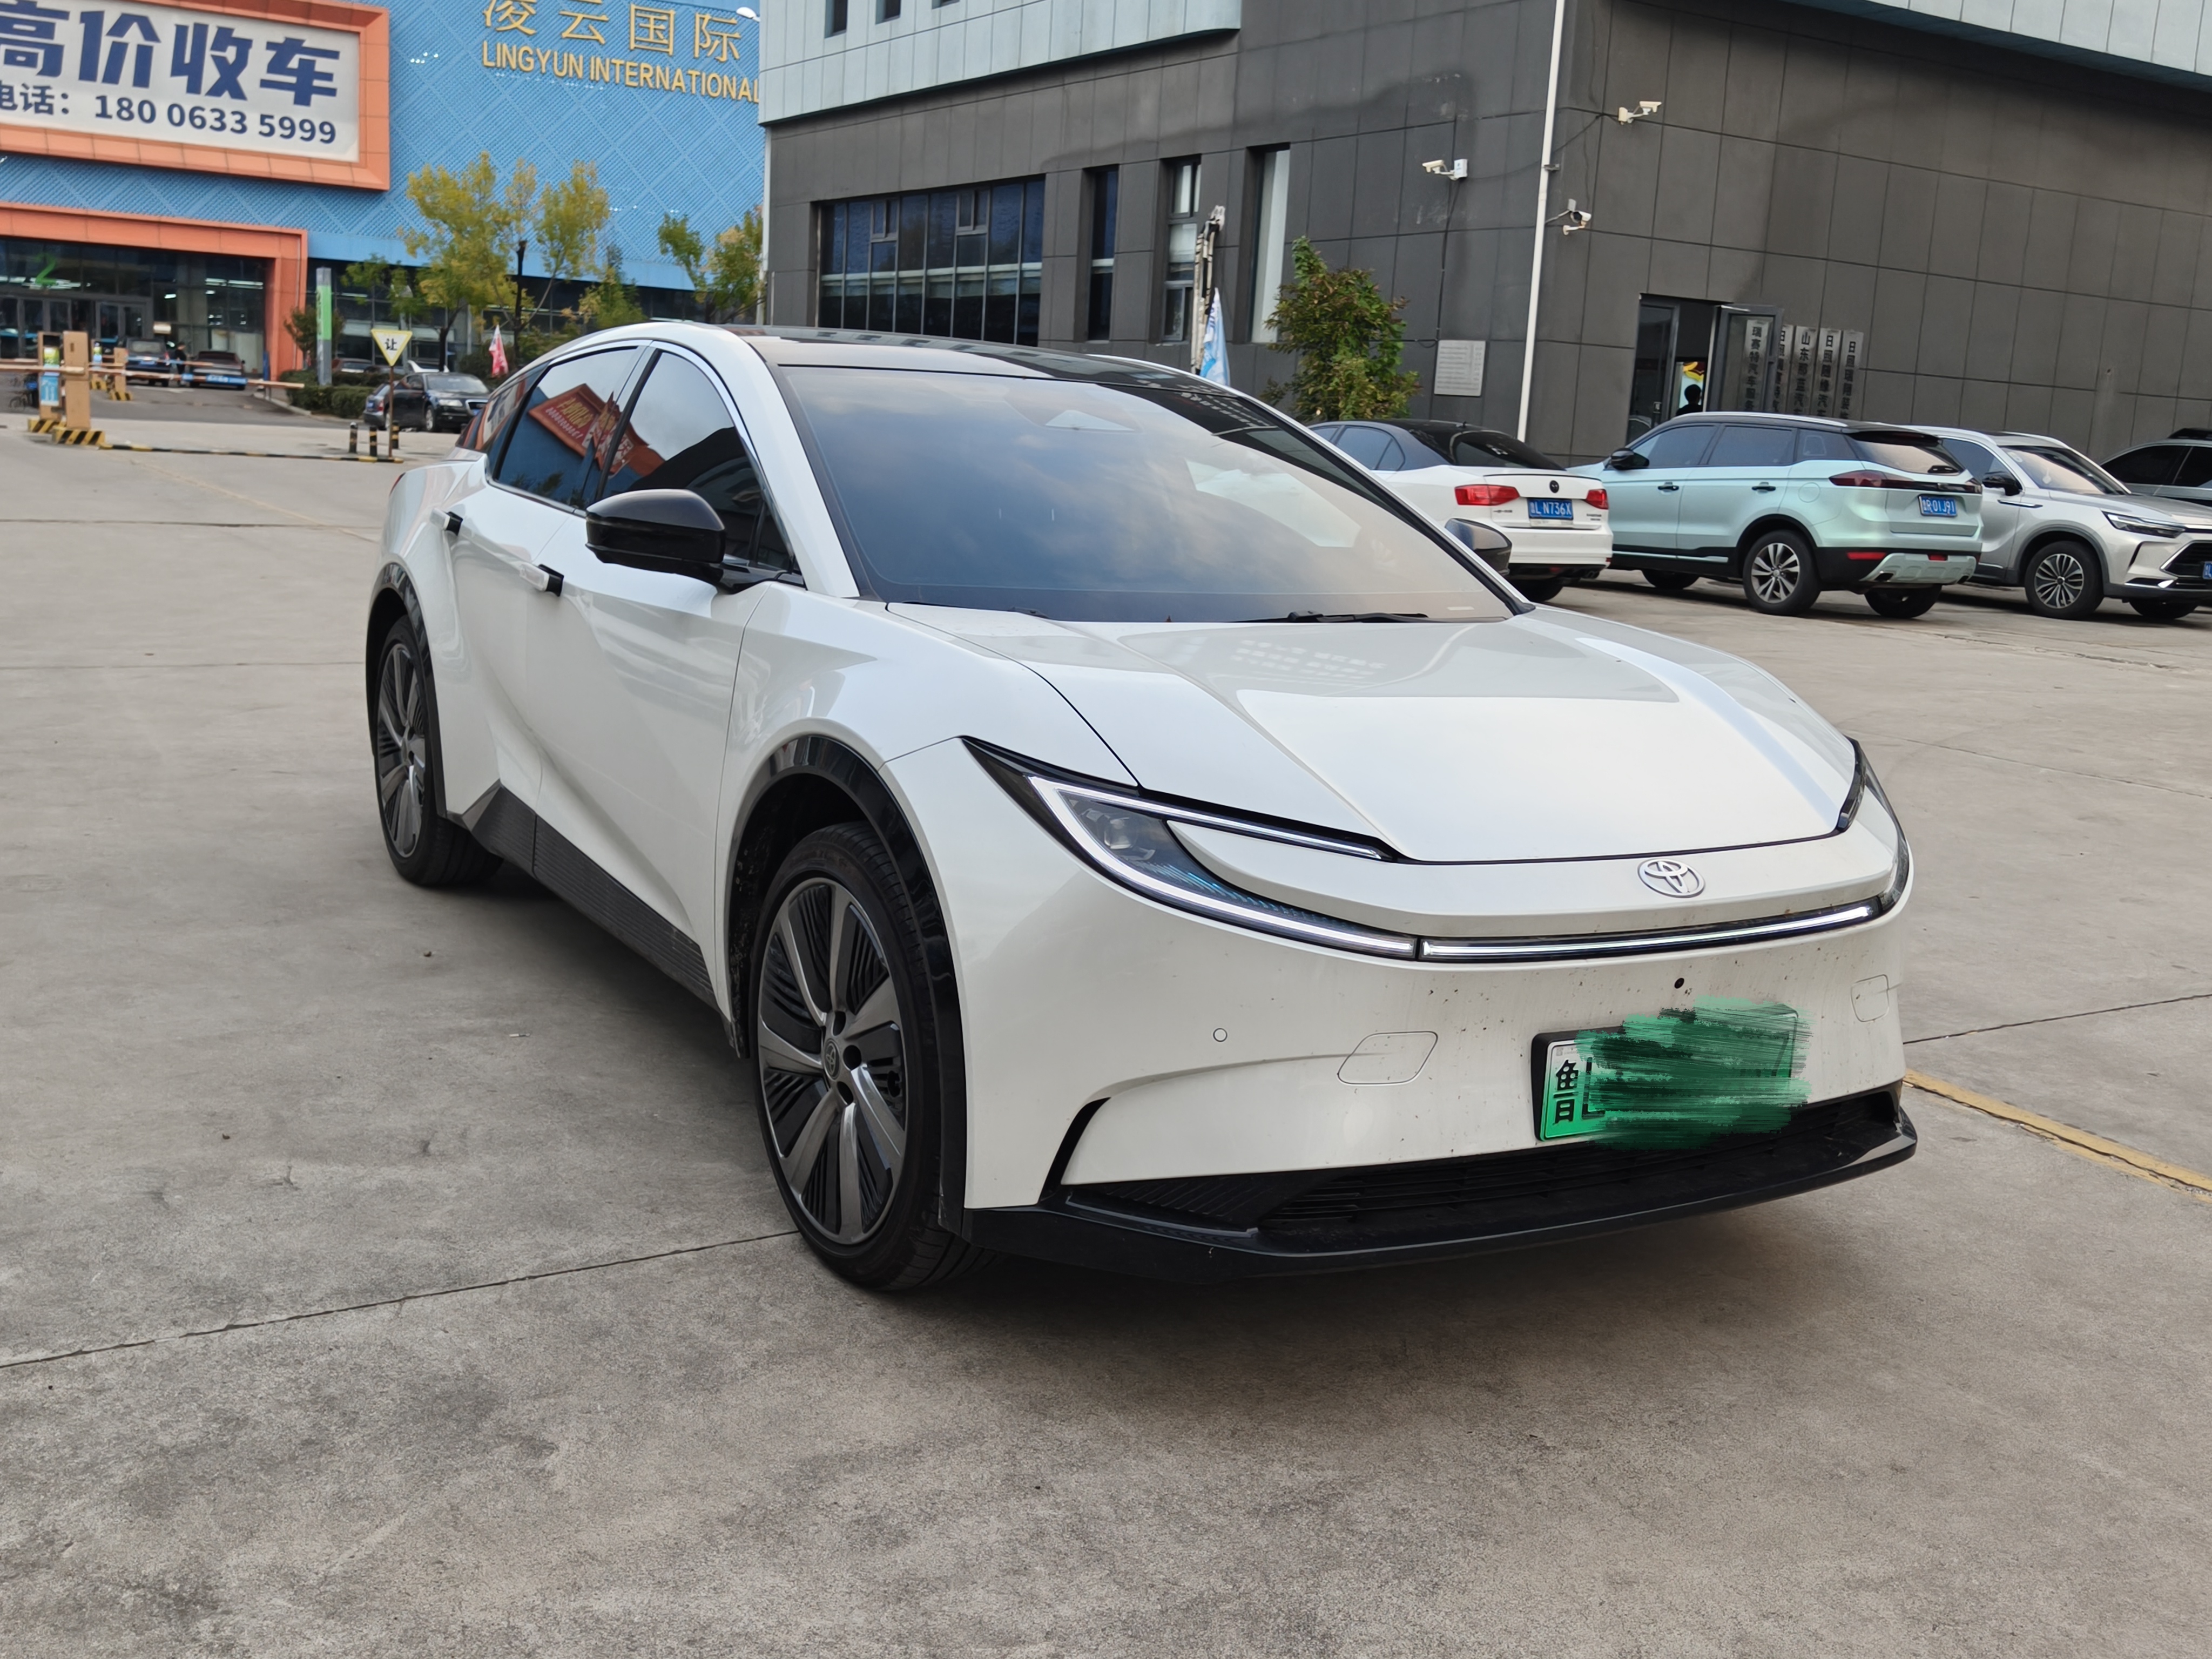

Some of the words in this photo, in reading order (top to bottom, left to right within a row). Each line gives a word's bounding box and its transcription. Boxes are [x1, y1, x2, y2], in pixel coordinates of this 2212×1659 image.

[0, 0, 340, 107] 高价收车
[482, 0, 740, 62] 凌云国际
[482, 40, 583, 79] LINGYUN
[589, 56, 759, 104] INTERNATIONAL
[95, 95, 157, 124] 180
[166, 103, 248, 134] 0633
[258, 114, 336, 144] 5999
[385, 338, 397, 350] 让
